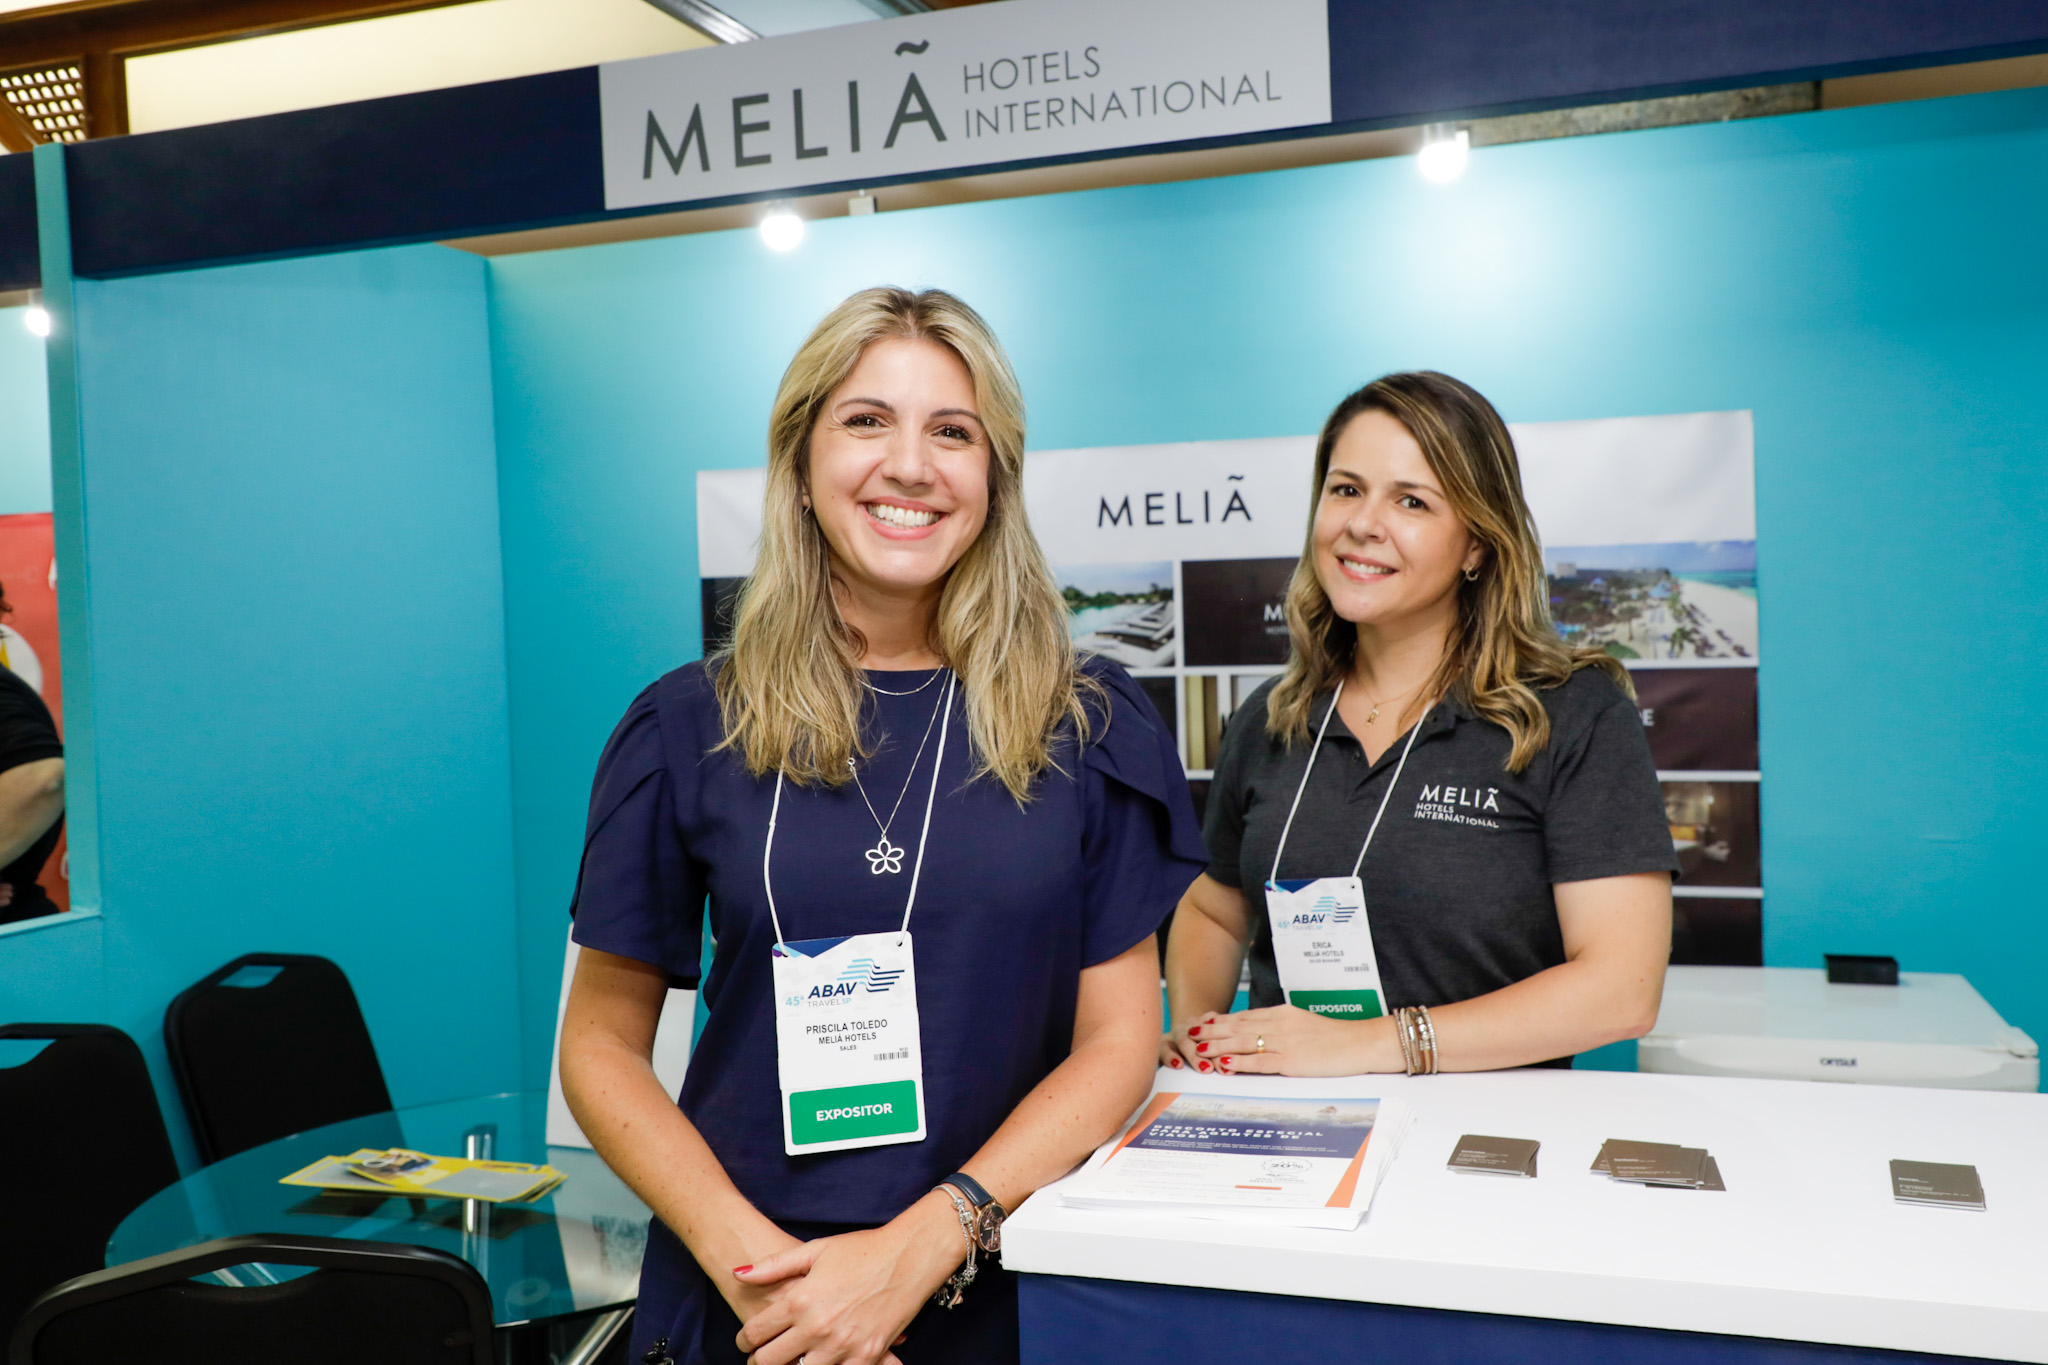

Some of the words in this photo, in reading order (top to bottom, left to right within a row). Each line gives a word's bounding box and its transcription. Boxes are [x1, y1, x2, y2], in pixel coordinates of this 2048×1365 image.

[963, 46, 1101, 94] HOTELS
[965, 71, 1283, 140] INTERNATIONAL
[1416, 803, 1454, 813] HOTELS
[1414, 811, 1499, 828] INTERNATIONAL
[1293, 914, 1326, 924] ABAV
[1312, 941, 1332, 949] ERICA
[808, 982, 857, 999] ABAV
[1308, 1004, 1363, 1013] EXPOSITOR
[806, 1022, 849, 1035] PRISCILA
[850, 1019, 888, 1031] TOLEDO
[845, 1032, 877, 1043] HOTELS
[816, 1103, 893, 1122] EXPOSITOR
[1149, 1131, 1210, 1139] VIAGEM
[1153, 1124, 1238, 1133] DESCONTO
[1245, 1128, 1323, 1137] ESPECIAL
